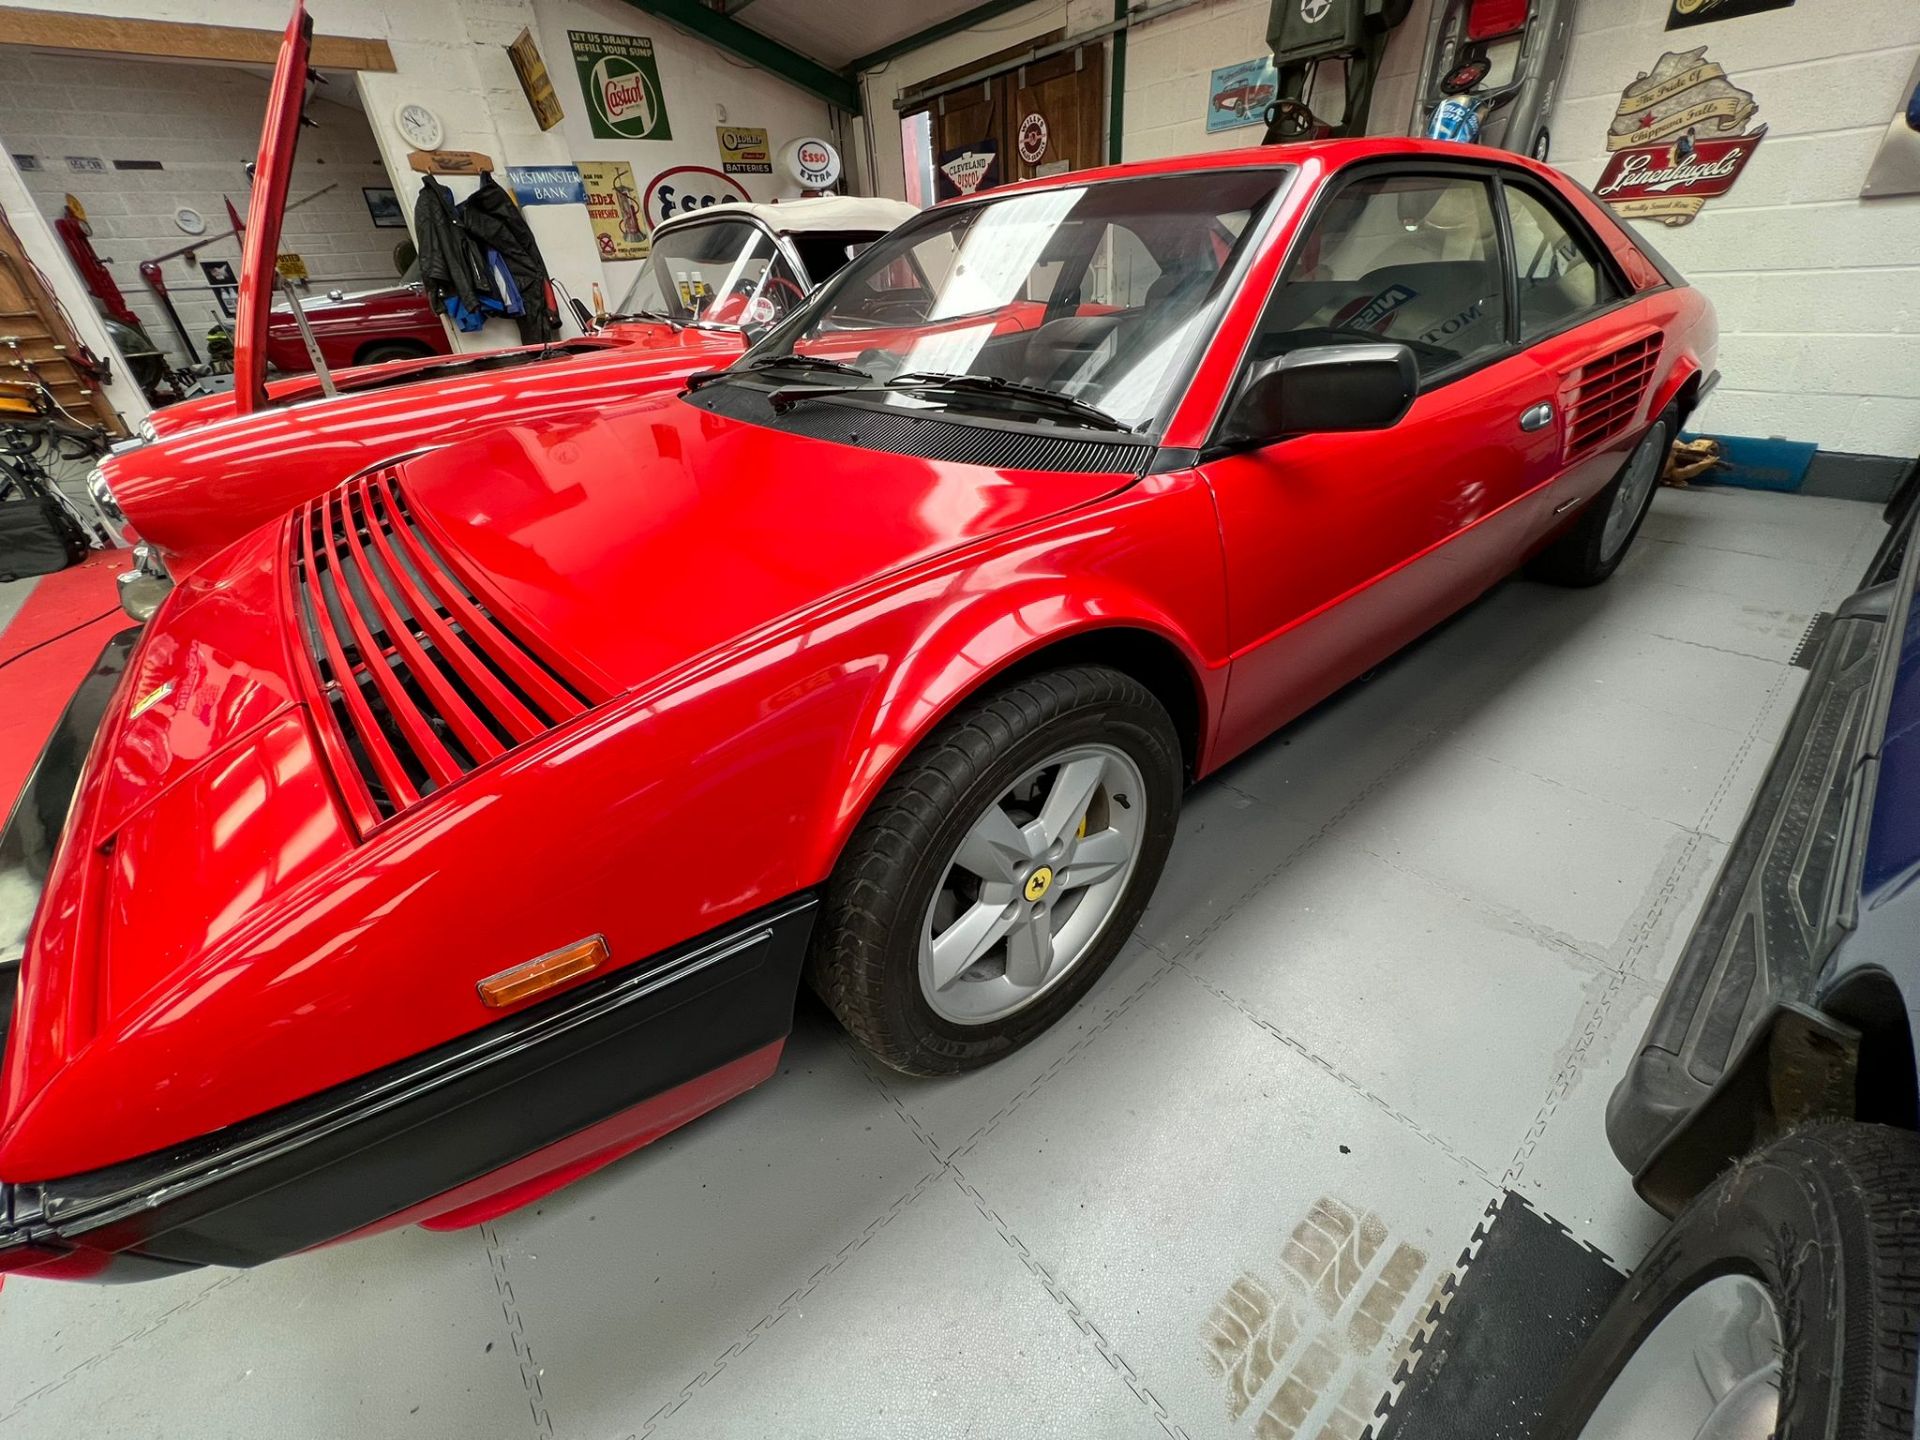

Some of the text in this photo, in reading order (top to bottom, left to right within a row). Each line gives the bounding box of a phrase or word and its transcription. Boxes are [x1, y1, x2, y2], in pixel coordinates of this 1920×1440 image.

[570, 31, 650, 48] LET US DRAIN AND
[573, 42, 652, 57] REFILL YOUR SUMP
[1656, 79, 1686, 96] Pride
[604, 75, 644, 117] Castrol
[1630, 102, 1718, 144] Chippewa Falls
[725, 163, 770, 173] BATTERIES
[948, 158, 987, 177] CLEVELAND
[509, 171, 581, 184] WESTMINSTER
[800, 170, 833, 183] EXTRA
[533, 186, 569, 200] BANK
